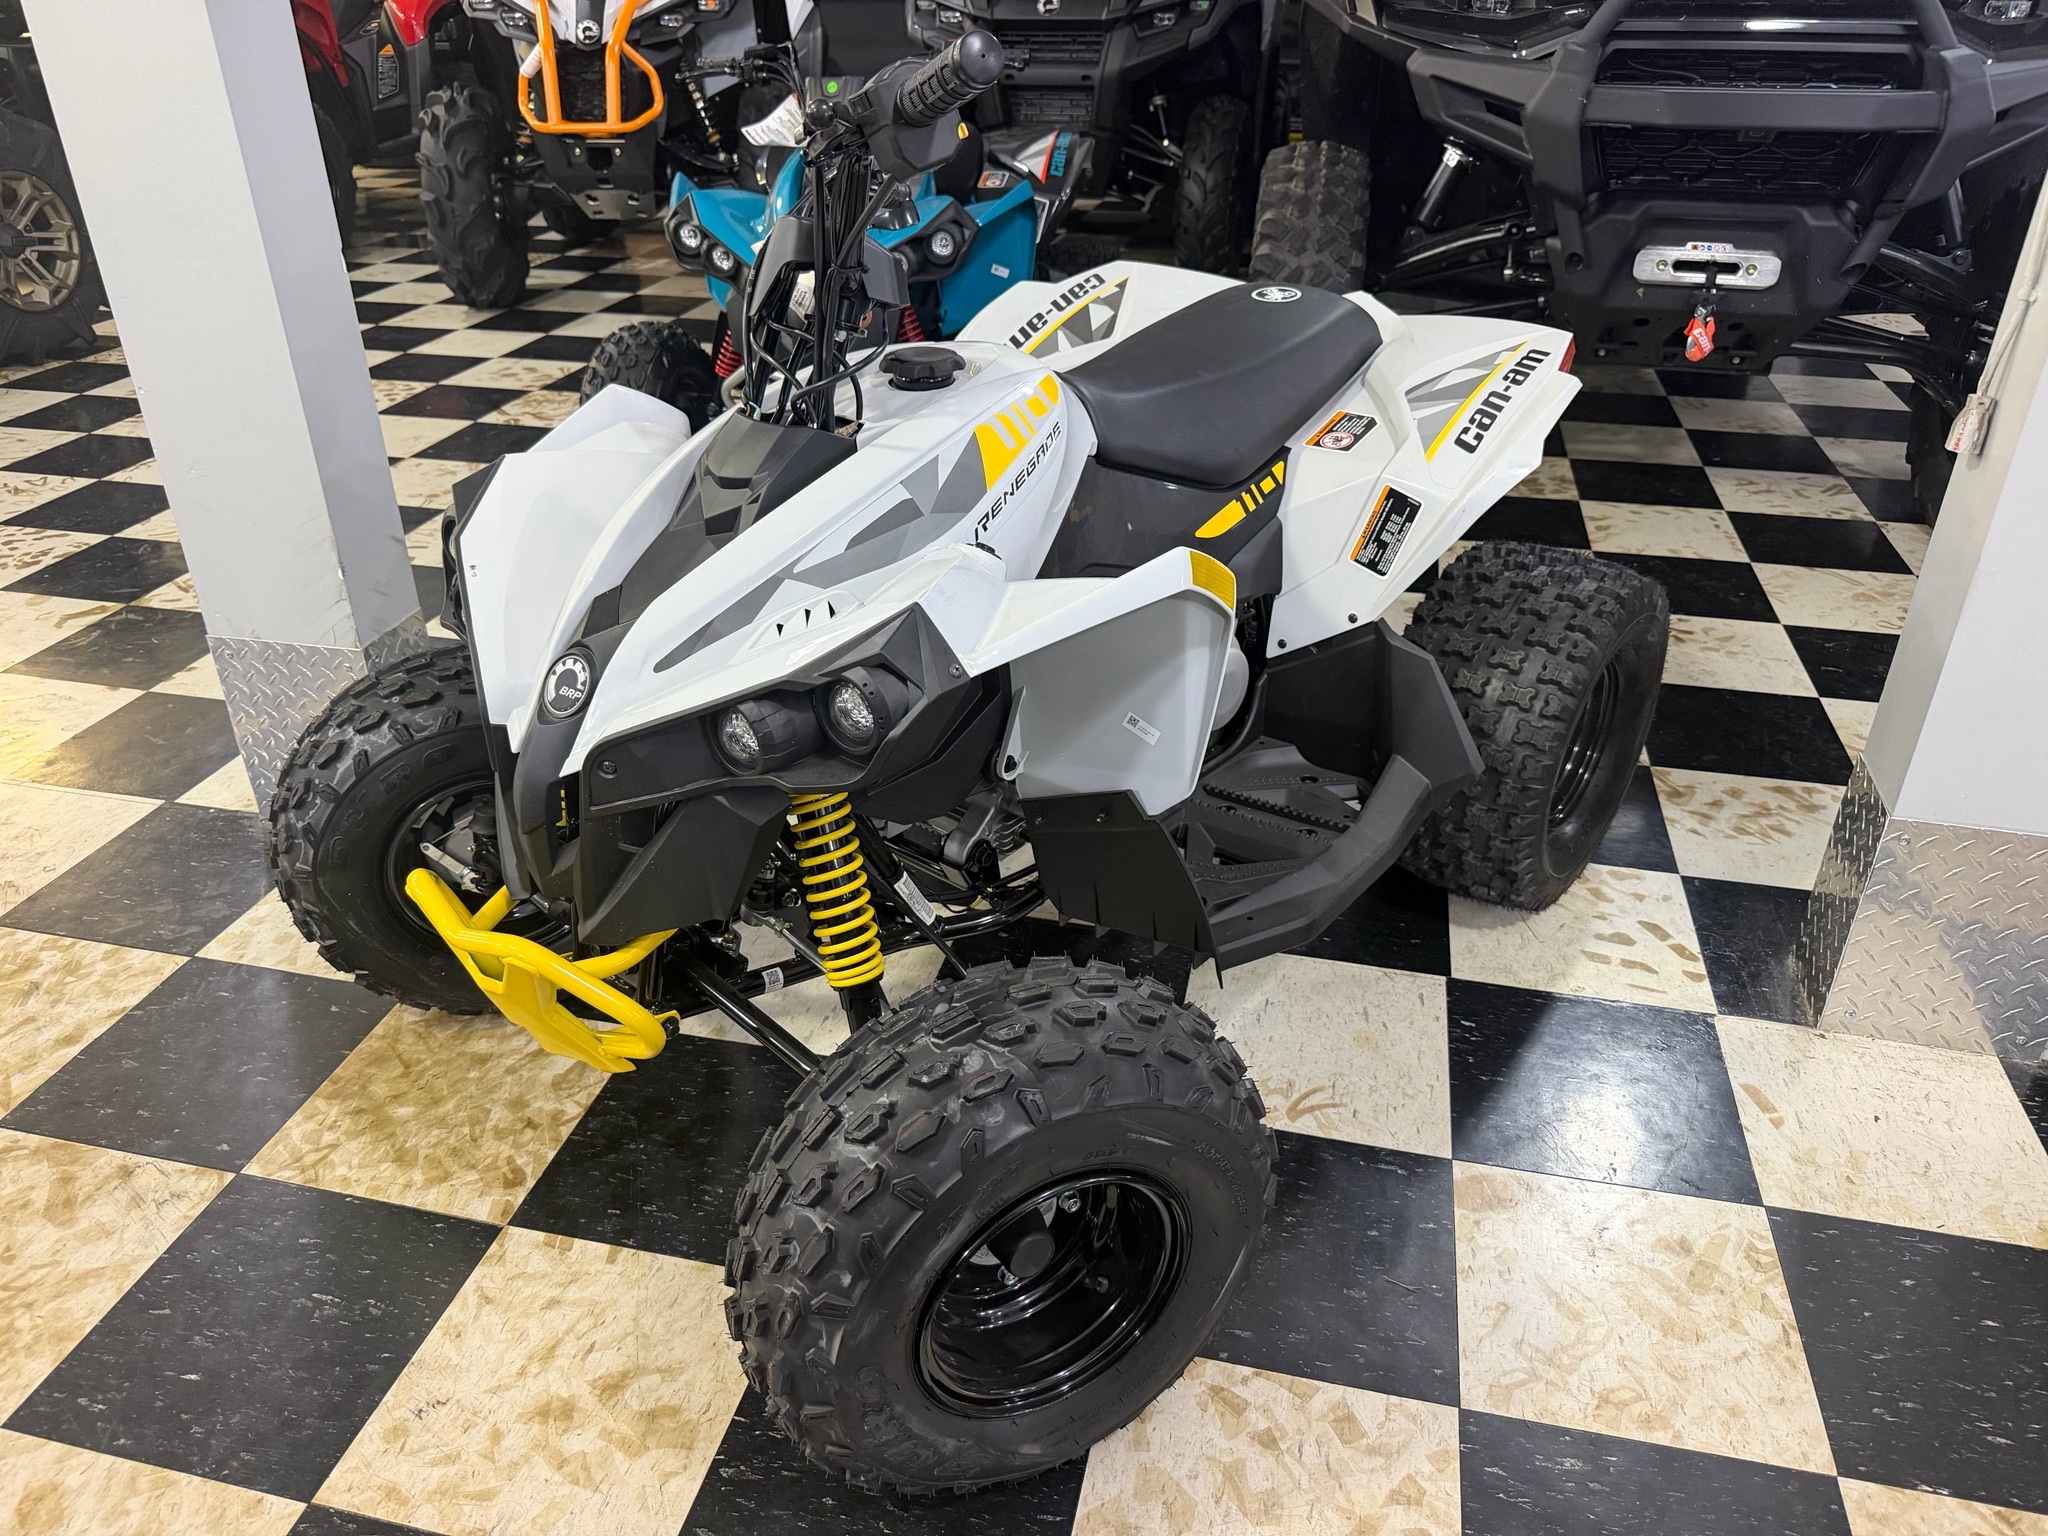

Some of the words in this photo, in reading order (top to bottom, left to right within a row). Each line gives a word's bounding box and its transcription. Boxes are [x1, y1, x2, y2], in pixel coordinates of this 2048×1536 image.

[1453, 348, 1552, 454] can-am
[974, 421, 1062, 543] RENEGADE
[558, 686, 582, 699] BRP
